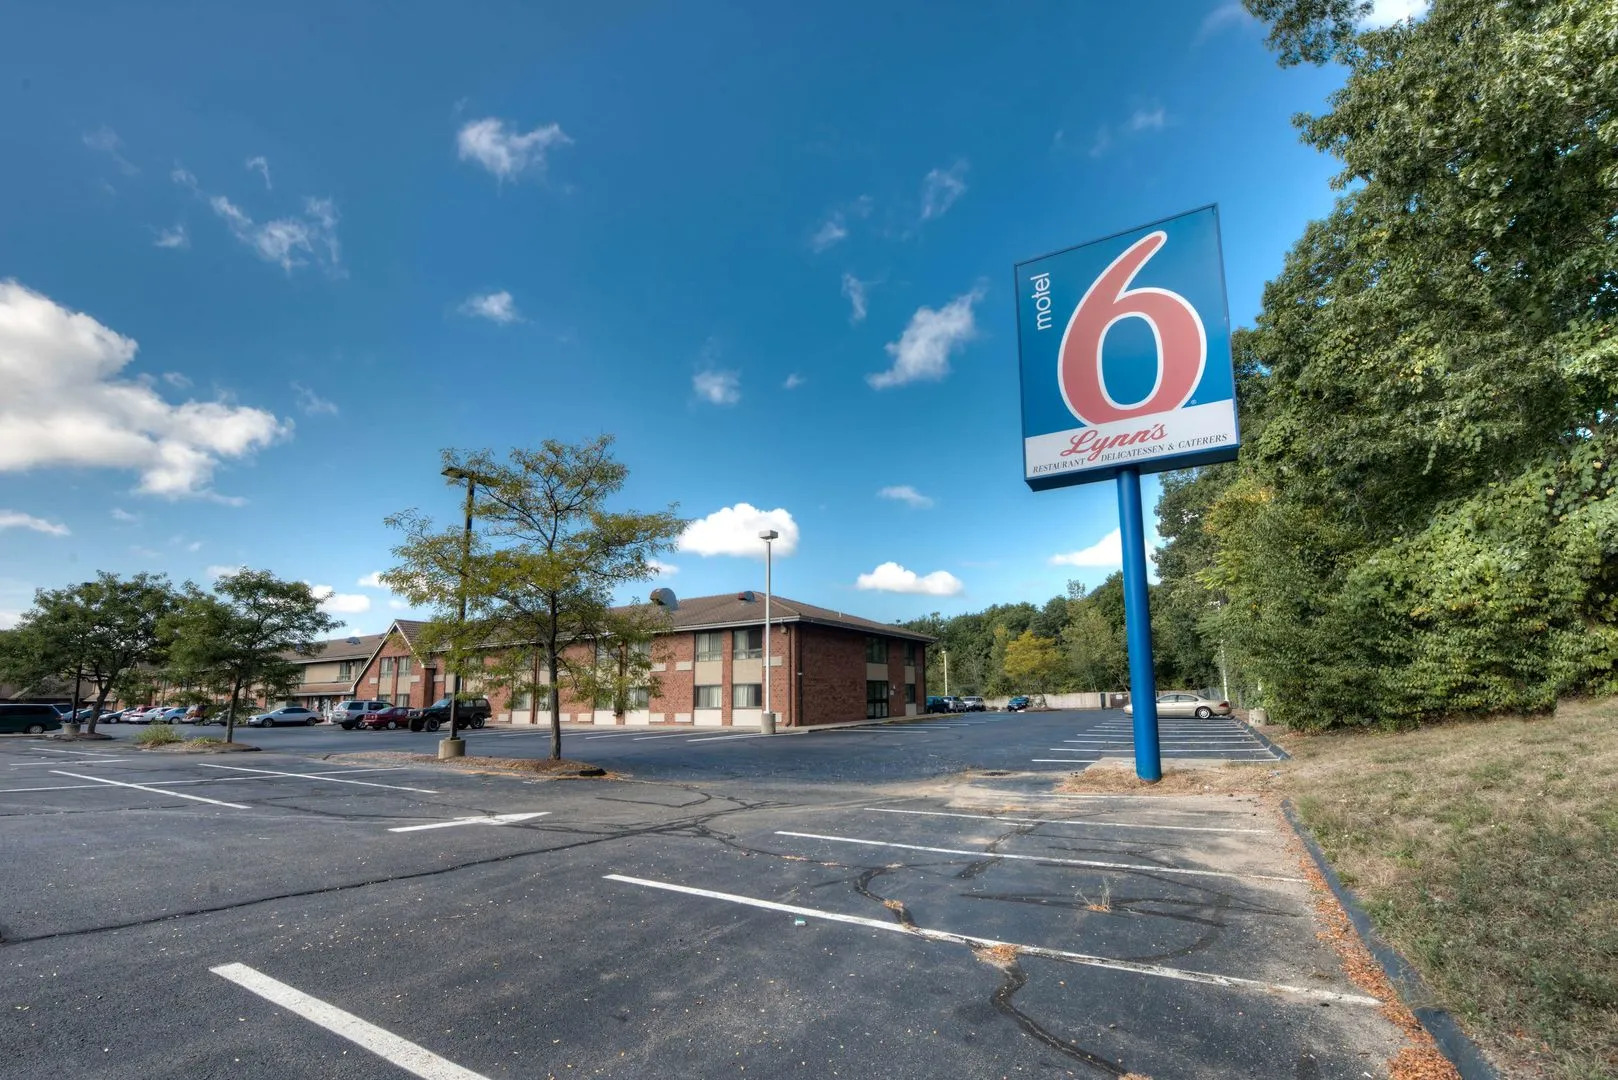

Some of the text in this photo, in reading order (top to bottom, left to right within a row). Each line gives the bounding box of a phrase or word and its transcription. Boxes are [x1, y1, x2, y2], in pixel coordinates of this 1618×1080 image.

[1030, 272, 1052, 331] motel
[1057, 230, 1207, 426] 6
[1033, 434, 1228, 474] RESTAURANT DELICATESSEN & CATERERS
[1060, 423, 1168, 462] Lynn's
